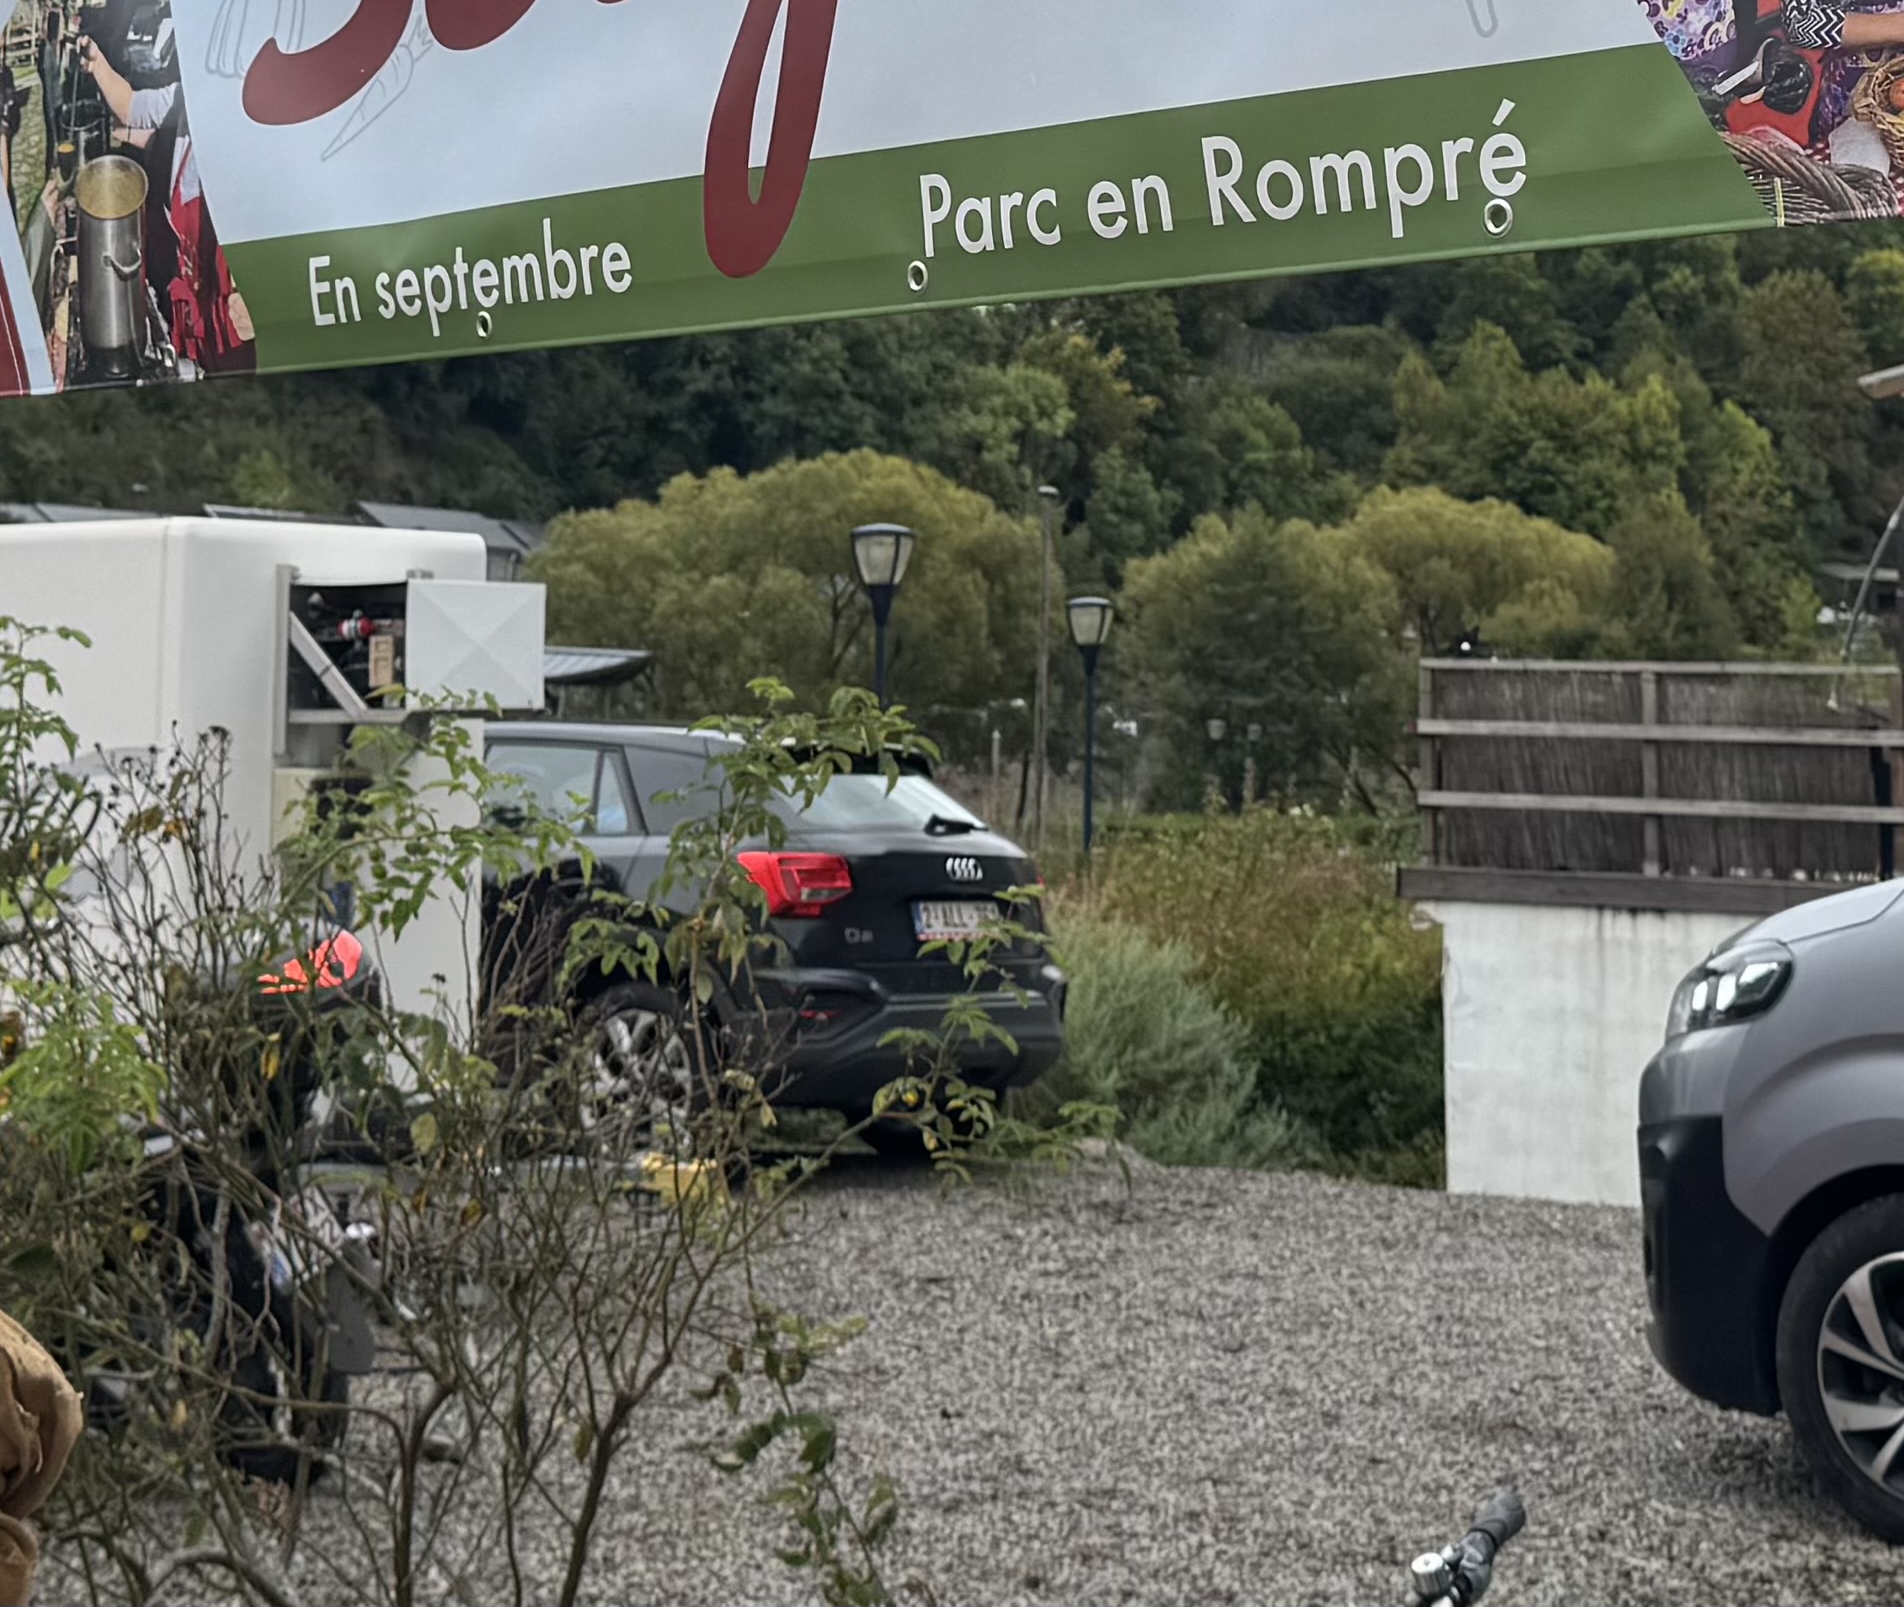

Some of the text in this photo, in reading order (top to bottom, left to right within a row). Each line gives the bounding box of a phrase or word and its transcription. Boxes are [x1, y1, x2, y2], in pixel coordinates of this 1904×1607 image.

[918, 97, 1528, 259] Parc en Rompré
[309, 217, 634, 338] En septembre
